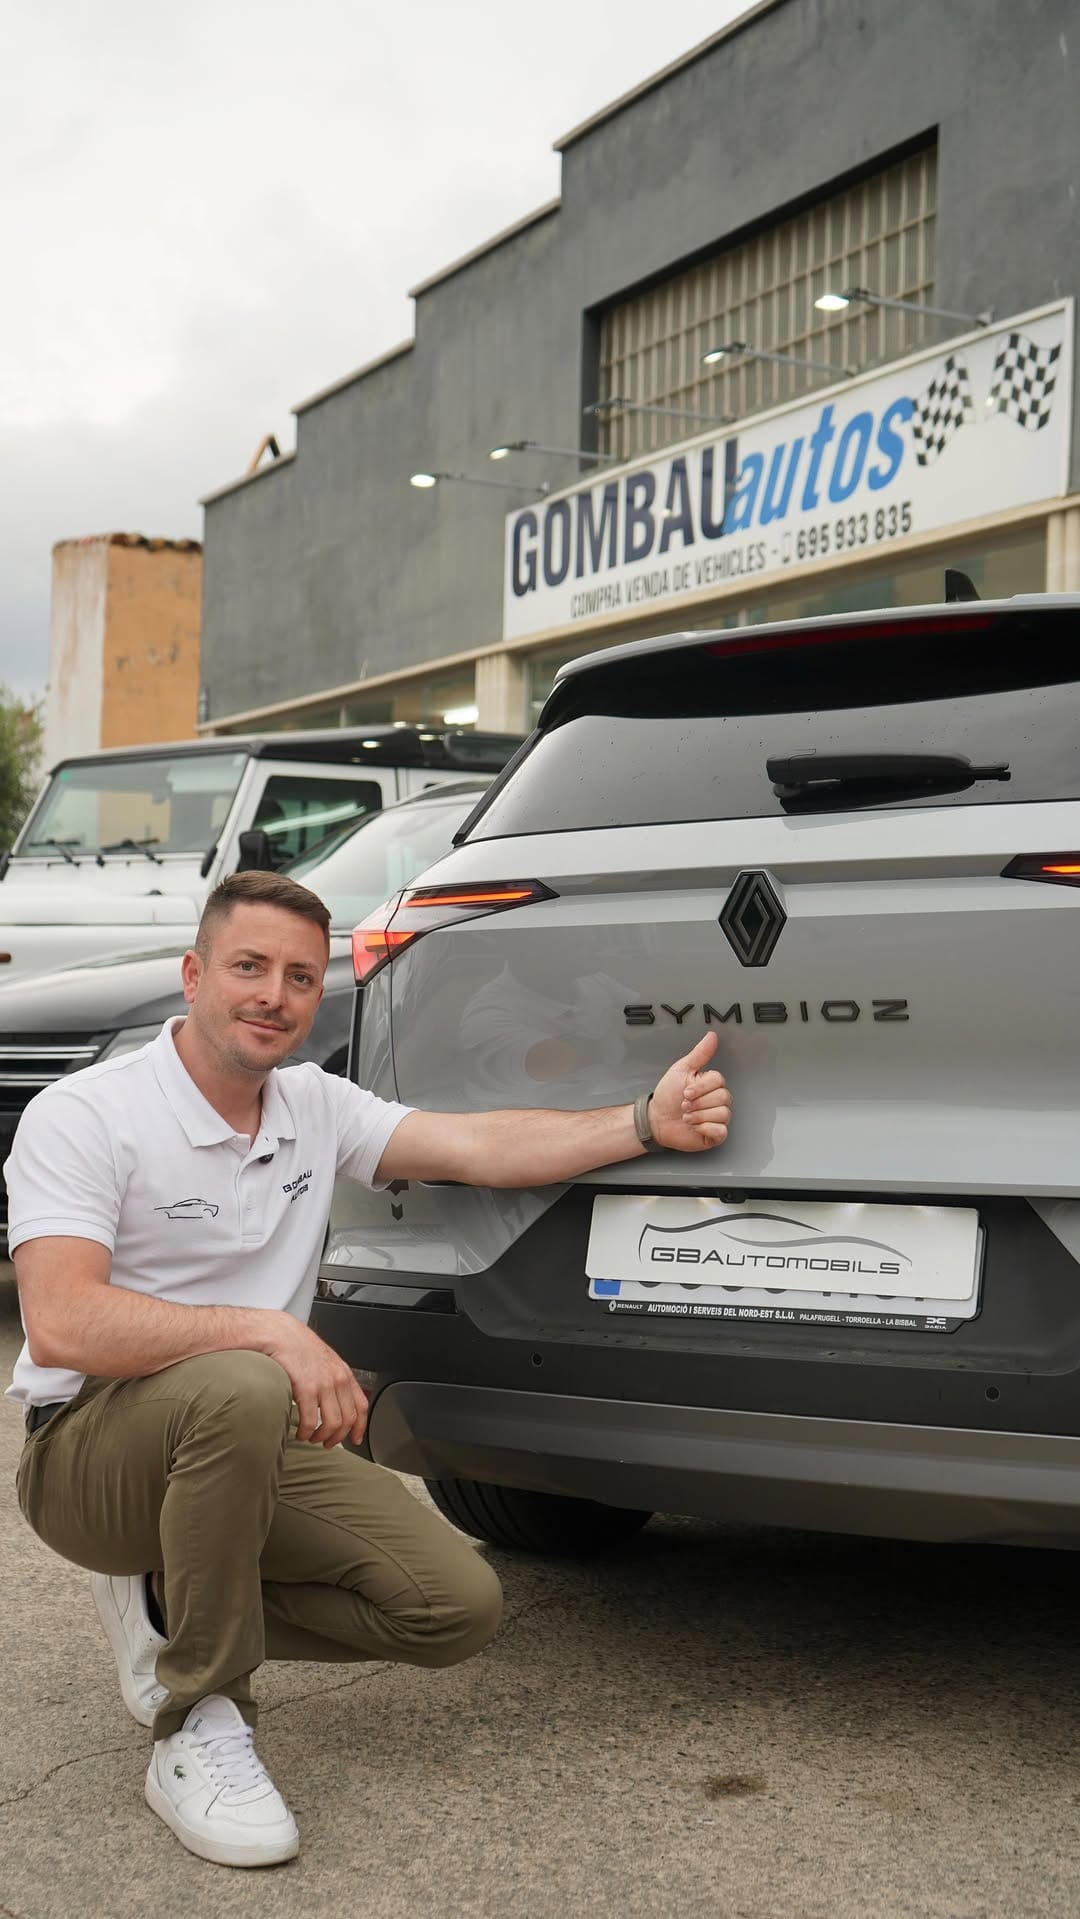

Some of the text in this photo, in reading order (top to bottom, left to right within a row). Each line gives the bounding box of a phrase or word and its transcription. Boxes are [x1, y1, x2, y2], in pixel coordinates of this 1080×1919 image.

[512, 395, 915, 597] GOMBAU autos
[570, 583, 622, 619] COMPRA
[625, 568, 670, 605] VENDA
[673, 559, 691, 592] DE
[695, 539, 767, 587] VEHICLES
[797, 524, 831, 560] 695
[835, 513, 868, 549] 933
[873, 501, 913, 541] 835
[624, 999, 910, 1025] SYMBIOZ
[647, 1302, 688, 1314] AUTOMOCIÓ
[693, 1307, 722, 1316] SERVEIS
[723, 1309, 737, 1317] DEL
[738, 1310, 774, 1319] NORD-EST
[775, 1311, 795, 1320] S.L.U.
[799, 1313, 841, 1323] PALAFRUGELL
[845, 1316, 881, 1325] TORROELLA
[895, 1319, 917, 1327] BISBAL
